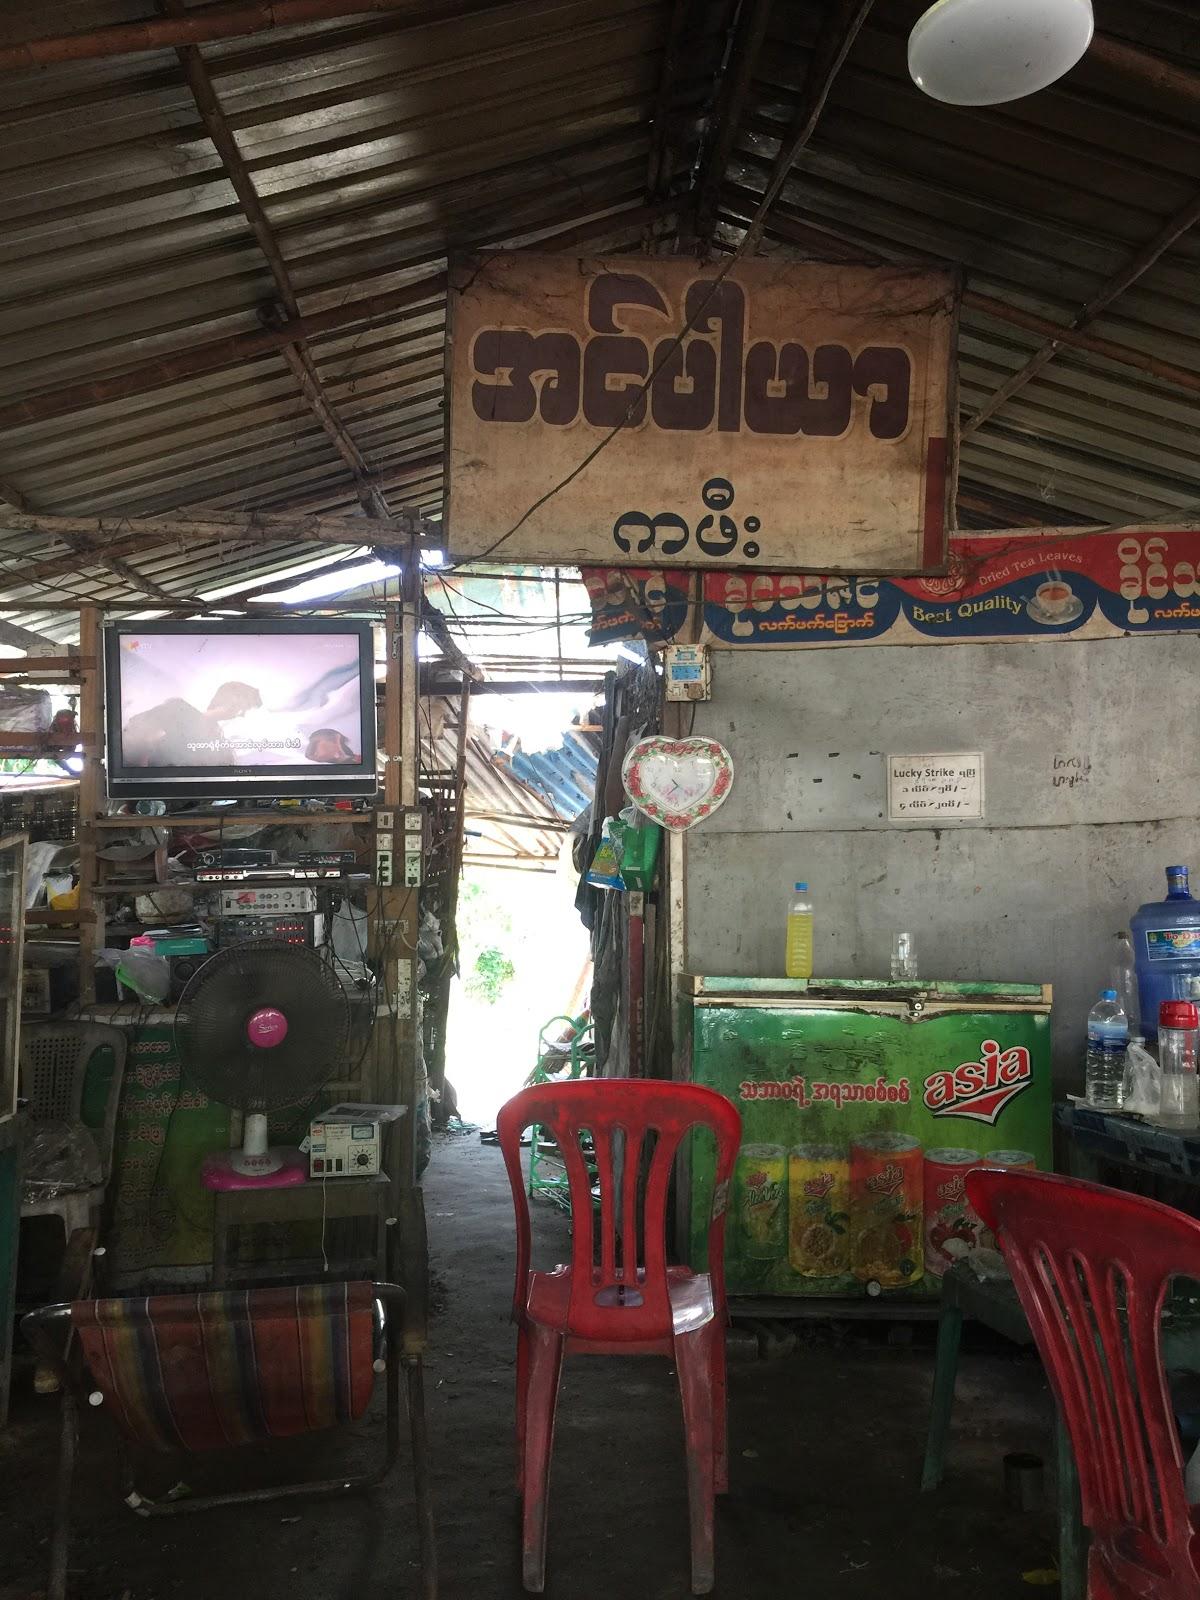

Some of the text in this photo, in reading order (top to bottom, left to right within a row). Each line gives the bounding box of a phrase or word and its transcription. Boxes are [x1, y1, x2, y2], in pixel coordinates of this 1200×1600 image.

[469, 272, 913, 442] အင်ပါယာ
[979, 551, 1083, 586] Dried Tea Leaves
[912, 595, 1022, 624] Best Quality
[894, 768, 922, 780] Lucky
[925, 768, 955, 778] Strike
[922, 1039, 1032, 1110] asia
